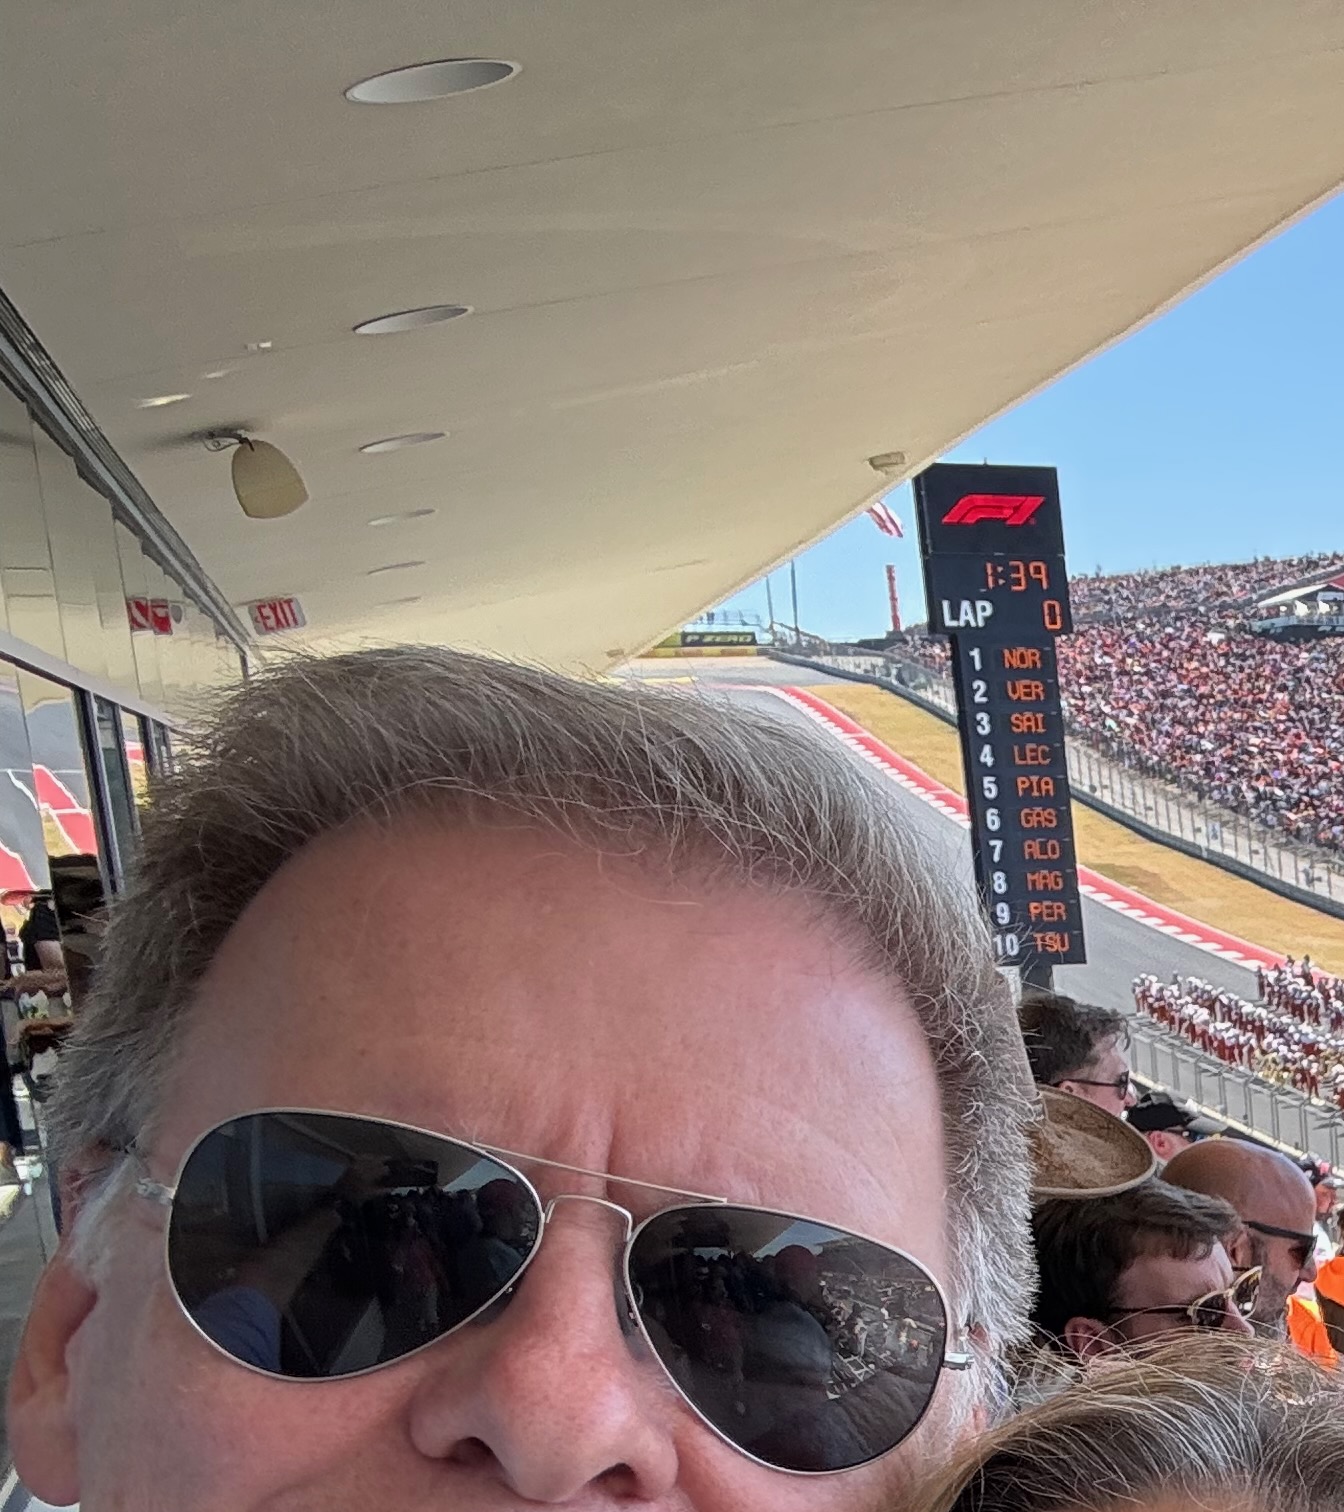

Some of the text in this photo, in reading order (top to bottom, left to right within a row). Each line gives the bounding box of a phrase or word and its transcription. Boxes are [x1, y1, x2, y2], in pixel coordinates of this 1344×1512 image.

[985, 560, 1049, 591] 1:39
[258, 599, 299, 632] EXIT
[942, 600, 1062, 630] LAP 0
[969, 647, 1042, 672] 1 NOR
[972, 679, 1045, 704] 2 VER
[975, 711, 1047, 736] 3 SAI
[979, 743, 1052, 768] 4 LEC
[982, 775, 1054, 799] 5 PIA
[985, 807, 1058, 832] 6 GAS
[988, 838, 1061, 864] 7 ALO
[992, 870, 1064, 894] 8 MAG
[996, 901, 1067, 926] 9 PER
[993, 932, 1070, 957] 10 TSU
